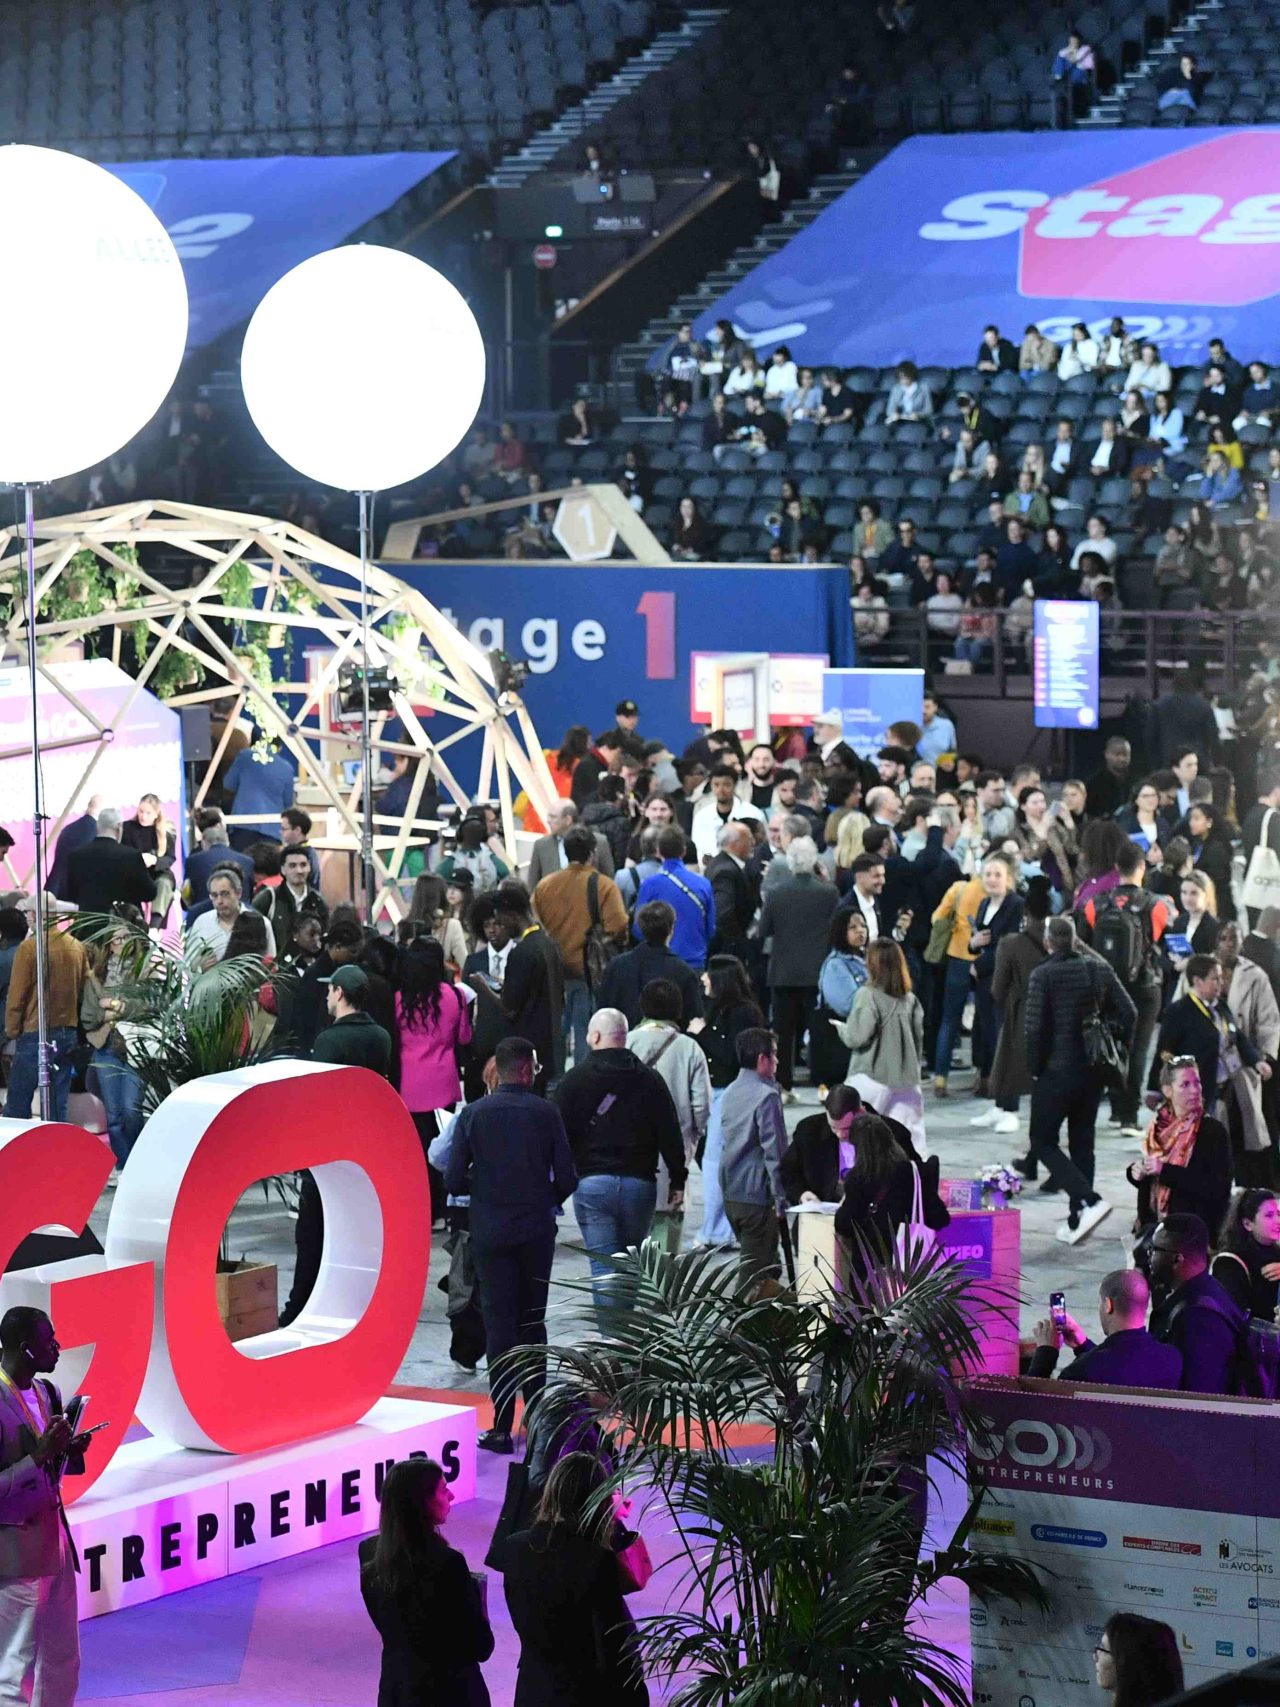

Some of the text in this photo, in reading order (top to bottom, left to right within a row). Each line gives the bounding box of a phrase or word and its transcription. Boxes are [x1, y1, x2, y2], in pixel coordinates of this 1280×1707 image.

[577, 503, 597, 546] 1
[636, 591, 676, 679] 1
[976, 1465, 1114, 1490] NTREPRENEURS
[1230, 1561, 1274, 1574] AVOCATS
